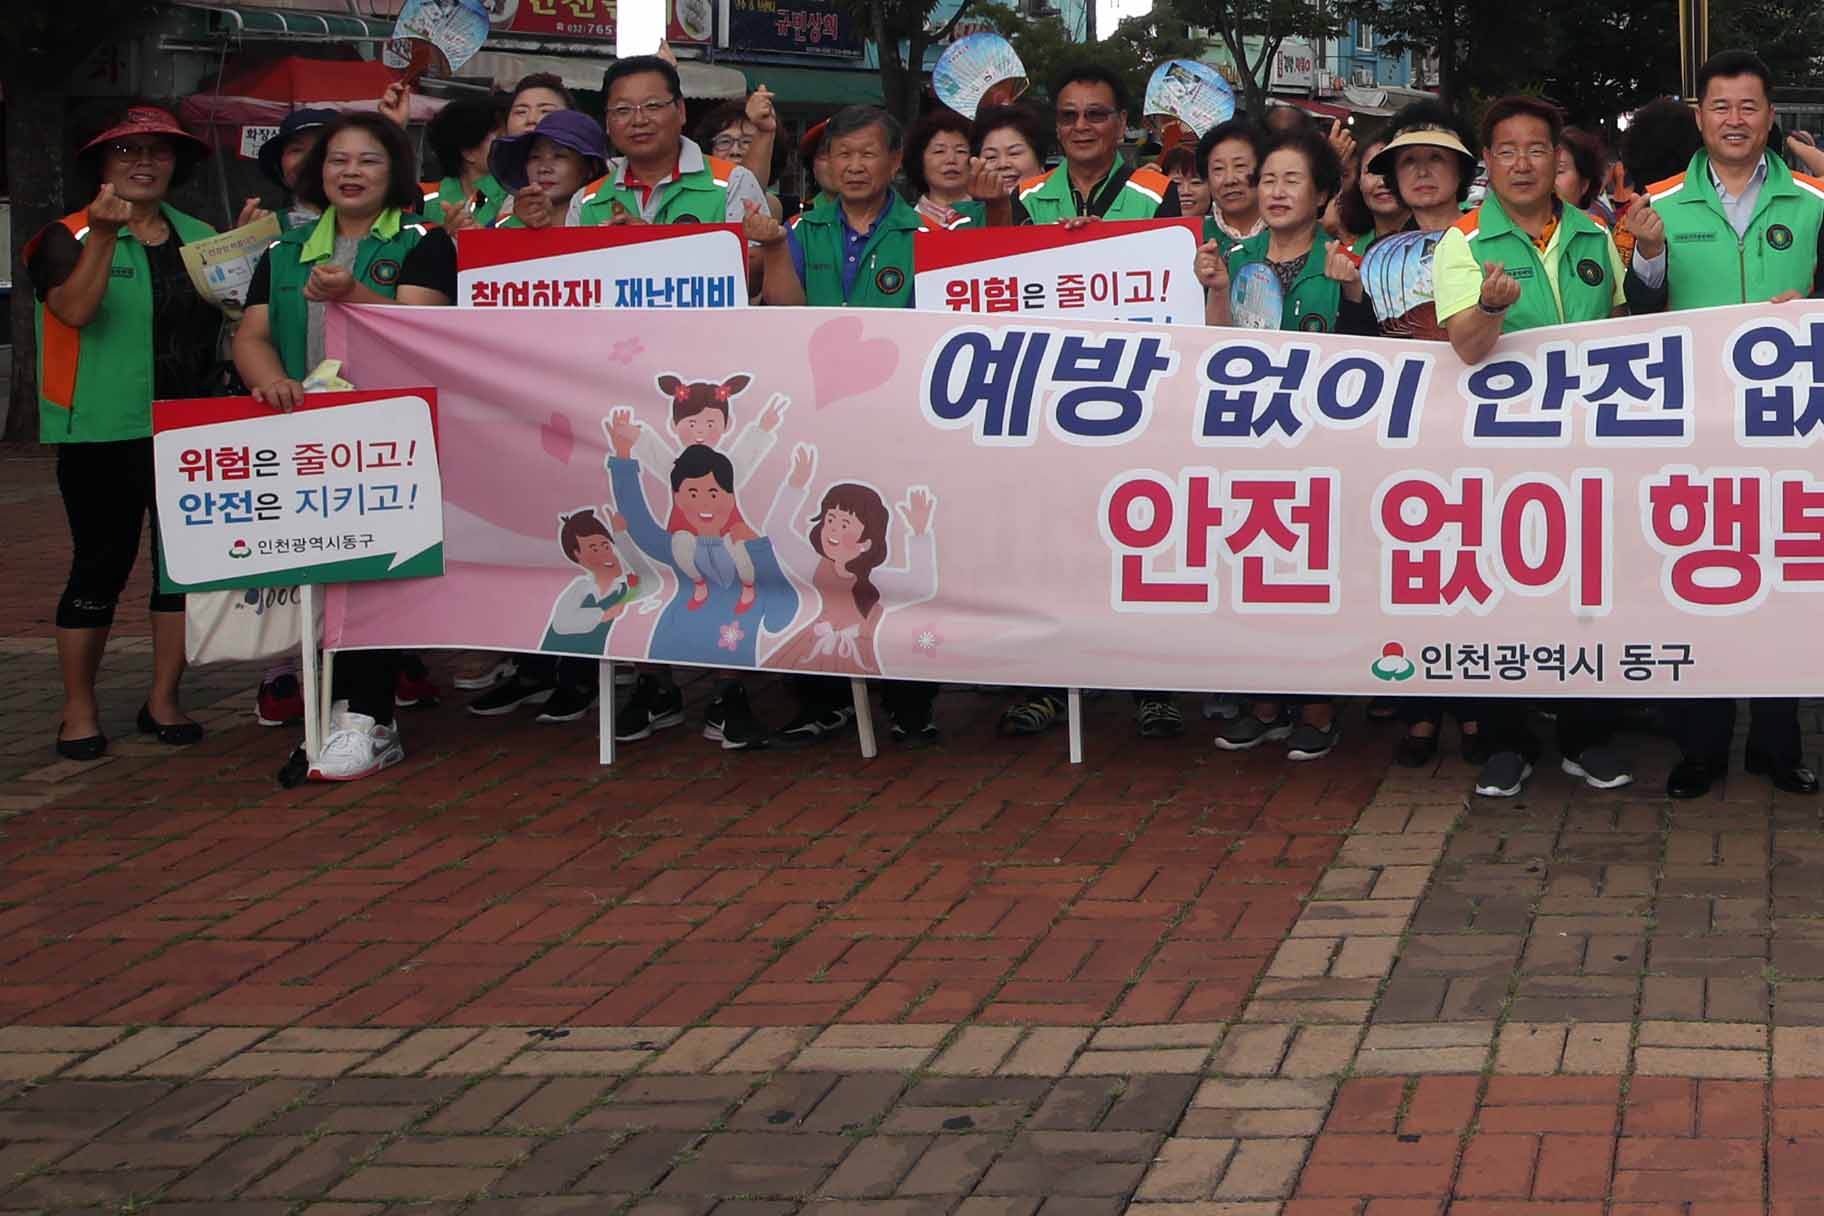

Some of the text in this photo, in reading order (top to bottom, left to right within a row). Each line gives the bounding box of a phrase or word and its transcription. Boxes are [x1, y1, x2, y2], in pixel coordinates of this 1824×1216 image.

[614, 274, 736, 308] 재난대비
[945, 269, 1171, 313] 위험은 줄이고!
[930, 328, 1171, 437] 예방
[1202, 345, 1425, 438] 없이
[1469, 335, 1685, 437] 안전
[178, 440, 418, 482] 위험은 줄이고!
[178, 483, 419, 526] 안전은 지키고!
[257, 533, 377, 555] 인천광역시동구
[1108, 476, 1332, 604] 안전
[1381, 478, 1603, 607] 없이
[1420, 642, 1695, 682] 인천광역시 동구
